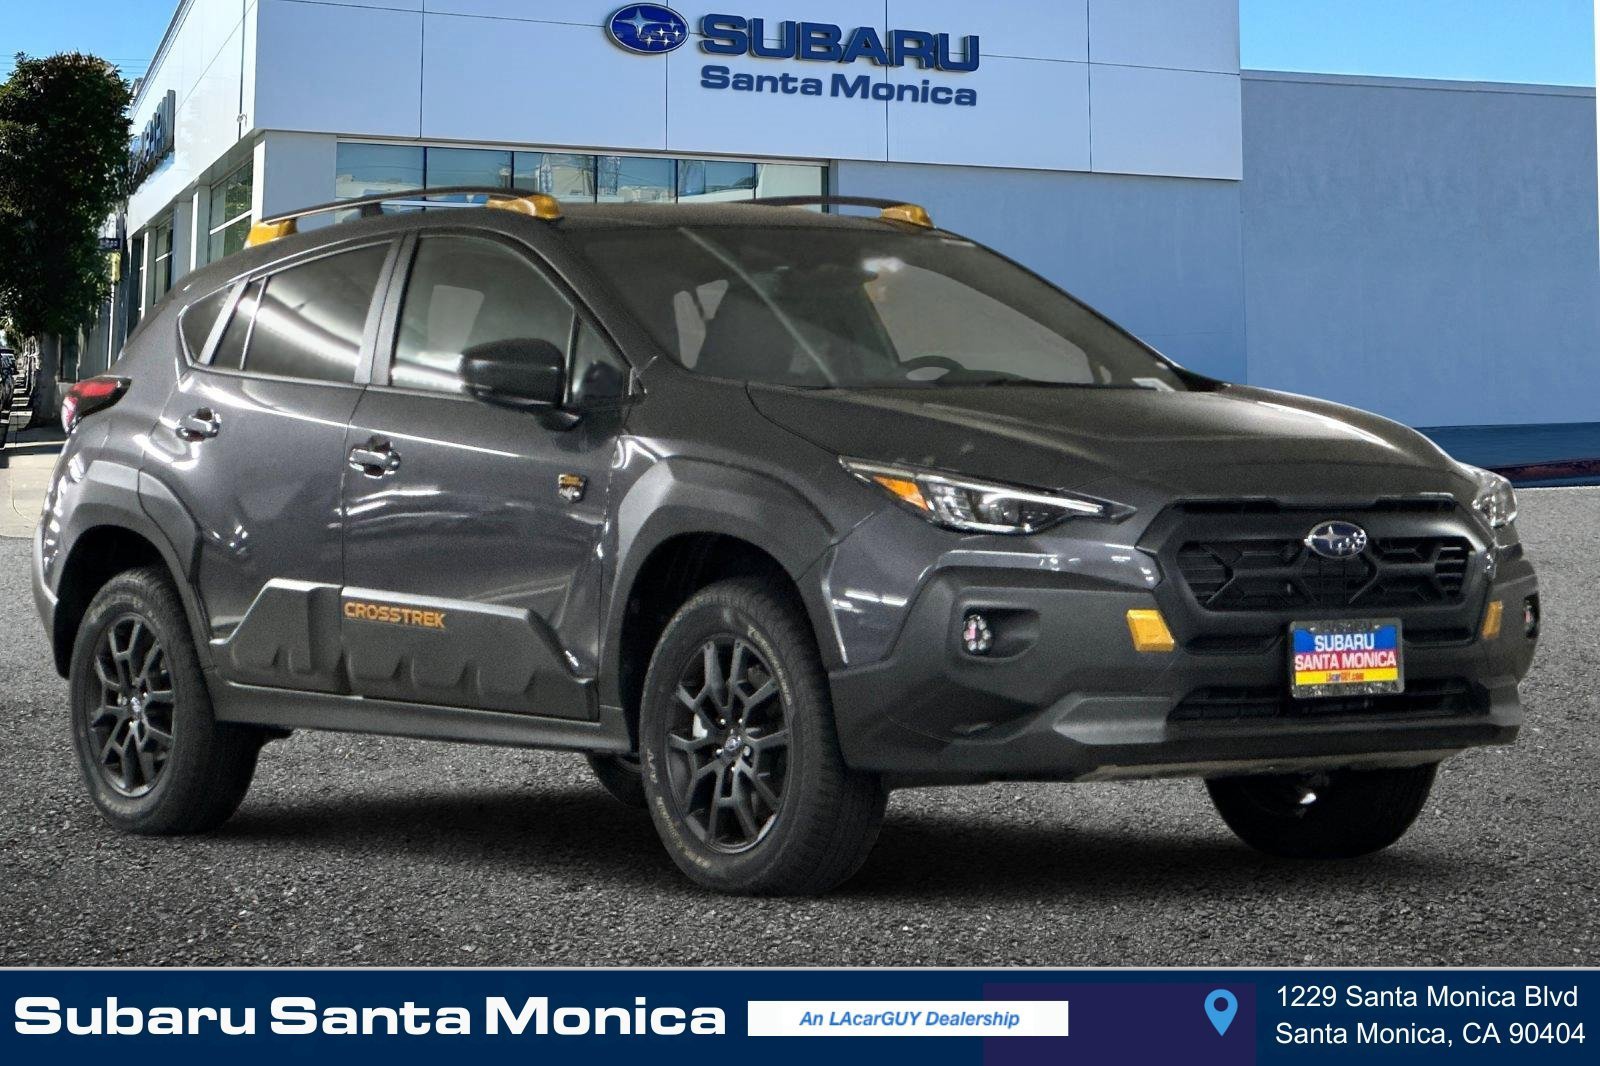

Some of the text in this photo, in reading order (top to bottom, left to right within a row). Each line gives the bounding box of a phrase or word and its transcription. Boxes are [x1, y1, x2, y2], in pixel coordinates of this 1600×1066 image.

[700, 12, 980, 72] SUBARU
[700, 65, 977, 106] Santa Monica
[344, 602, 447, 628] CROSSTREK
[1314, 633, 1375, 652] SUBARU
[1294, 651, 1396, 671] SANTA MONICA
